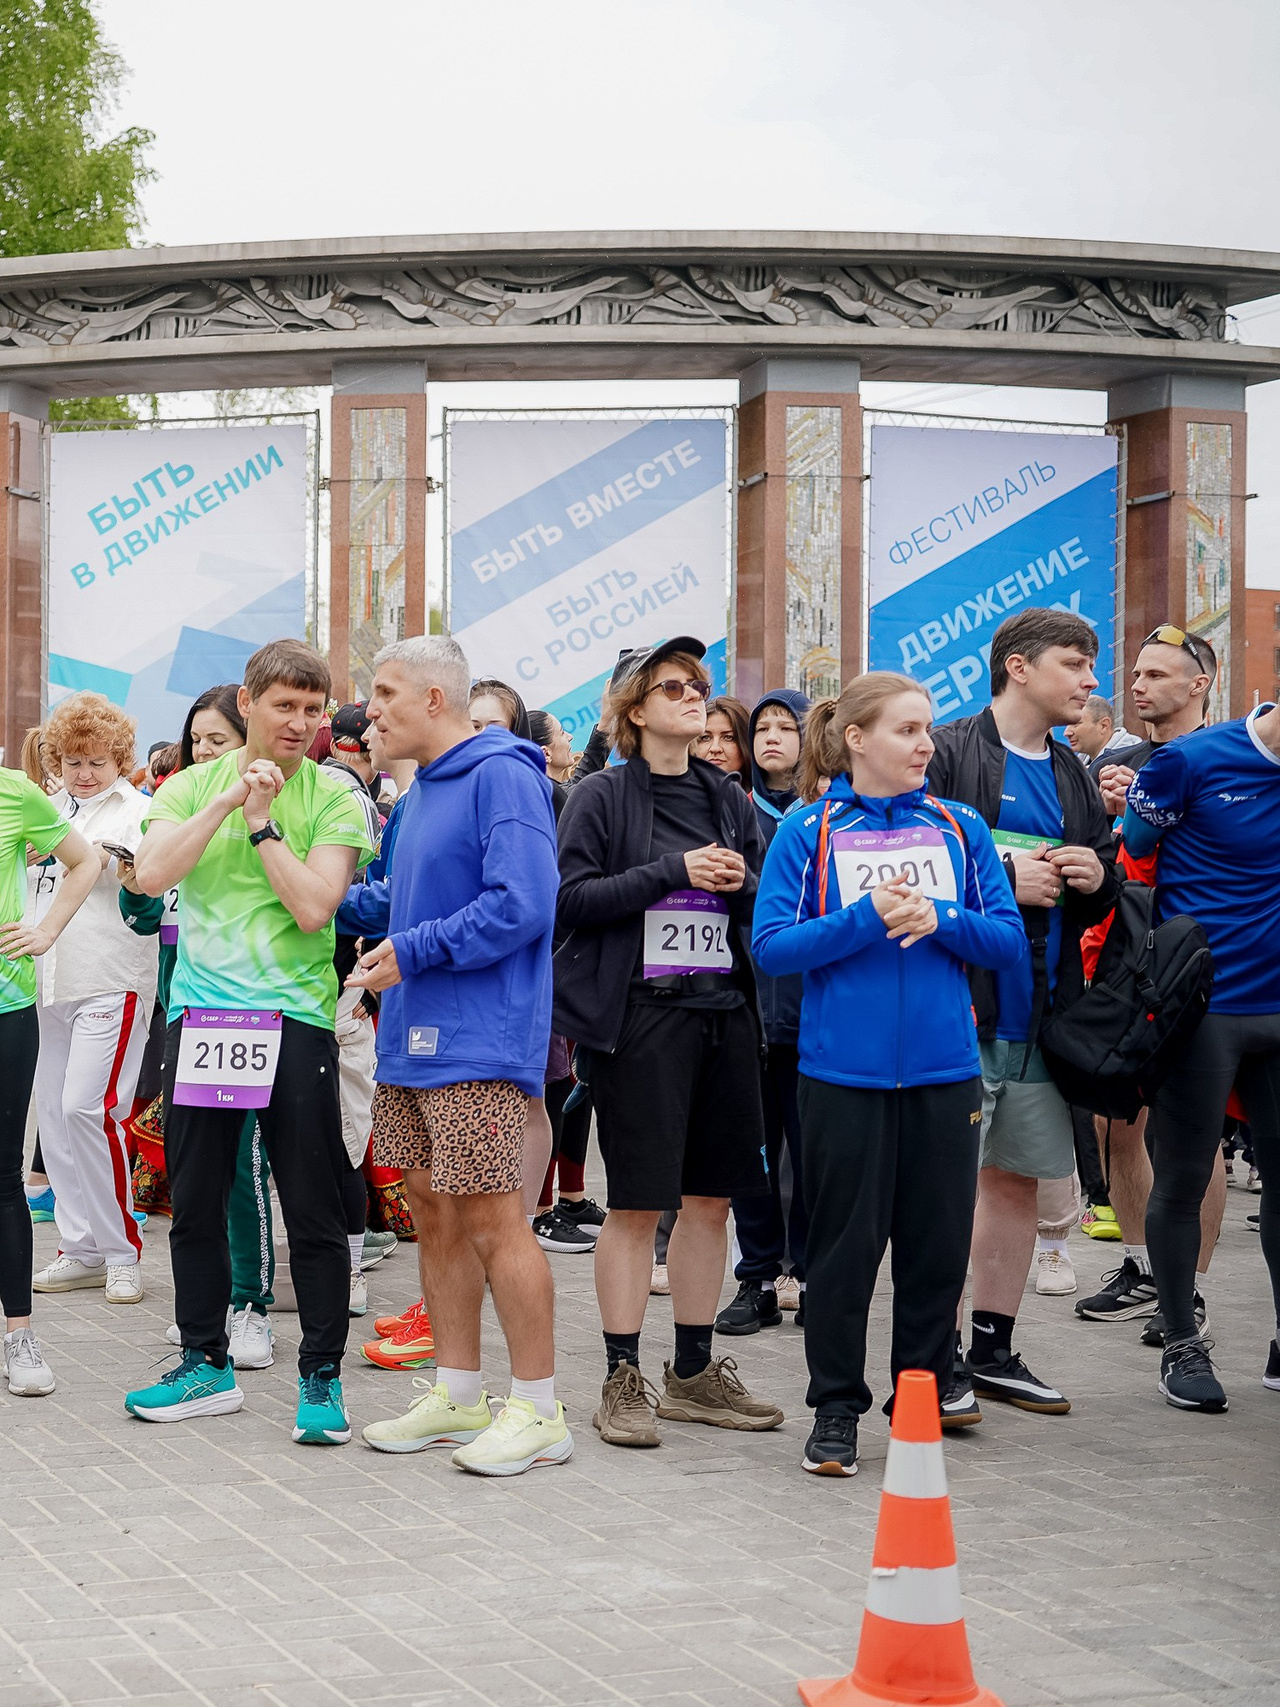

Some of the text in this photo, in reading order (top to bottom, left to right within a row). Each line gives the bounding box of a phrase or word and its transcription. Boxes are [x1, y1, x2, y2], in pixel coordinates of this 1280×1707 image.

[70, 444, 284, 590] В ДВИЖЕНИИ
[87, 461, 195, 536] БЫТЬ
[470, 438, 702, 584] БЫТЬ ВМЕСТЕ
[888, 460, 1056, 565] ФЕСТИВАЛЬ
[515, 562, 700, 682] С РОССИЕЙ
[545, 568, 638, 629] БЫТЬ
[898, 536, 1091, 675] ДВИЖЕНИЕ
[856, 859, 939, 891] 2001
[661, 923, 725, 953] 2192
[194, 1041, 268, 1071] 2185
